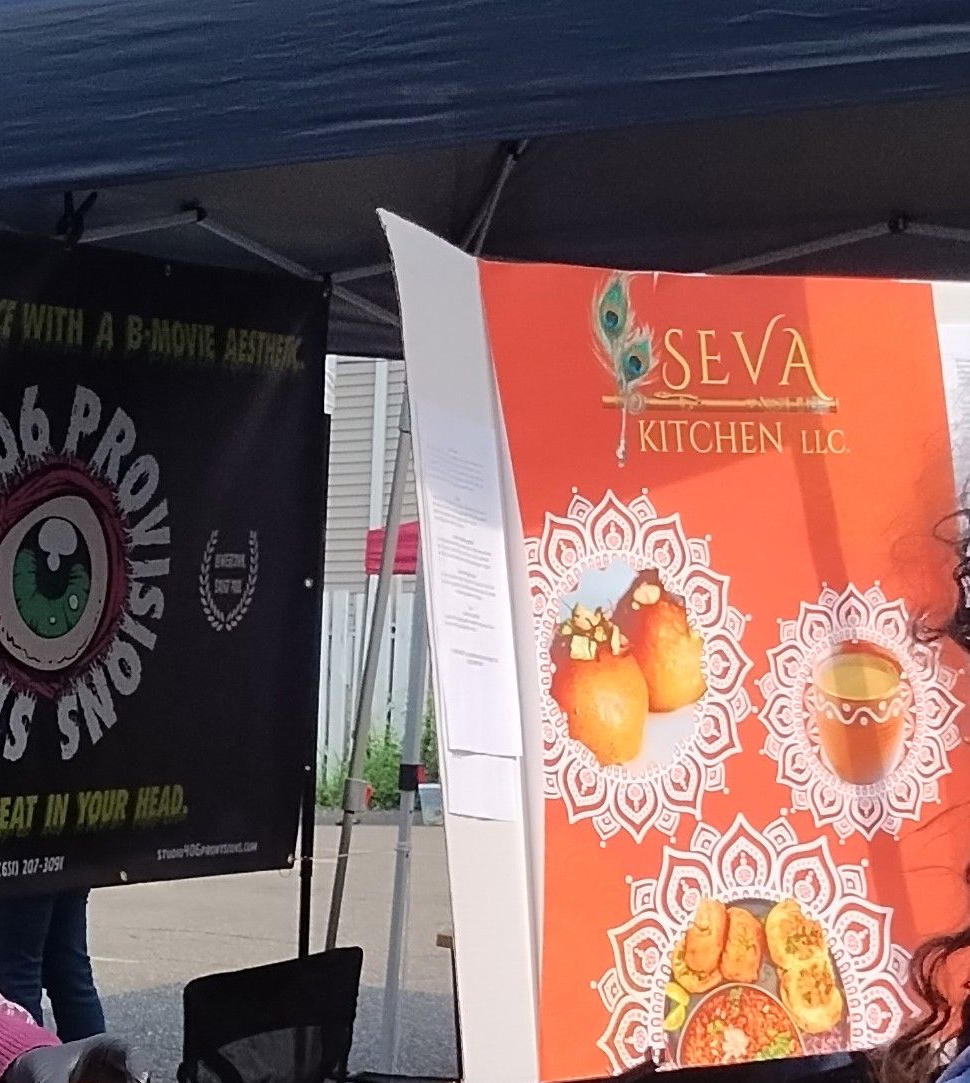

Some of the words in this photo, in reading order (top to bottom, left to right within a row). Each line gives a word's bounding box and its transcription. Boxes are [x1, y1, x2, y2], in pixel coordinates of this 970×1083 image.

[22, 303, 83, 346] WITH
[96, 311, 114, 351] A
[125, 314, 215, 359] B-MOVIE
[662, 313, 833, 401] SEVA
[639, 419, 784, 454] KITCHEN
[801, 429, 851, 454] LLC.
[57, 384, 171, 761] PROVISIONS
[44, 793, 70, 829] IN
[77, 788, 129, 826] YOUR
[134, 784, 189, 819] HEAD.
[22, 856, 66, 875] 207-3091
